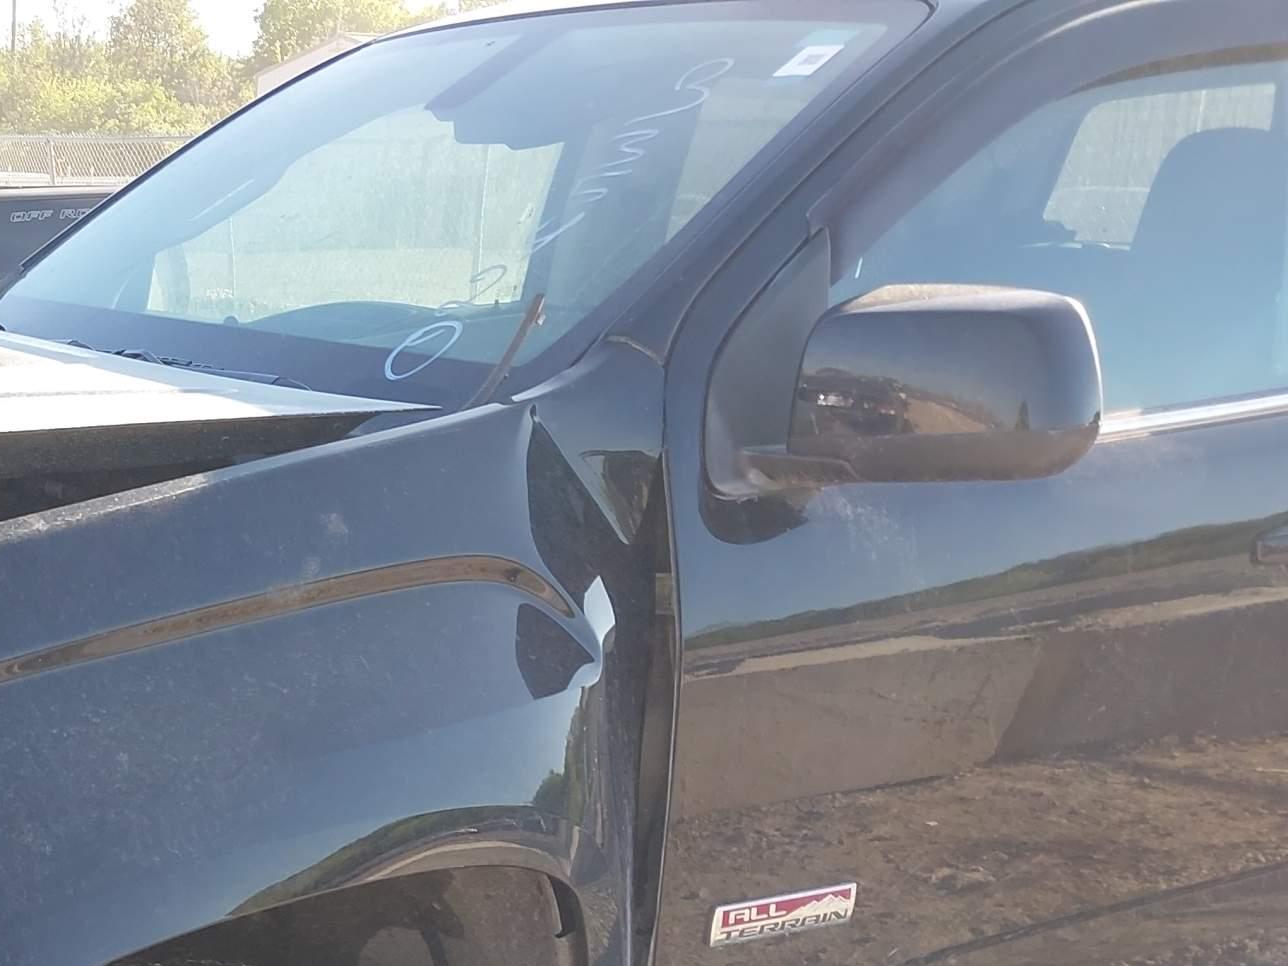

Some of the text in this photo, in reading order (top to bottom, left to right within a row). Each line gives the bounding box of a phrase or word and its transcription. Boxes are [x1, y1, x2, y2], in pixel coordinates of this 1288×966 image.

[10, 210, 53, 222] OFF
[716, 909, 848, 941] TERRAIN
[728, 903, 787, 925] ALL
